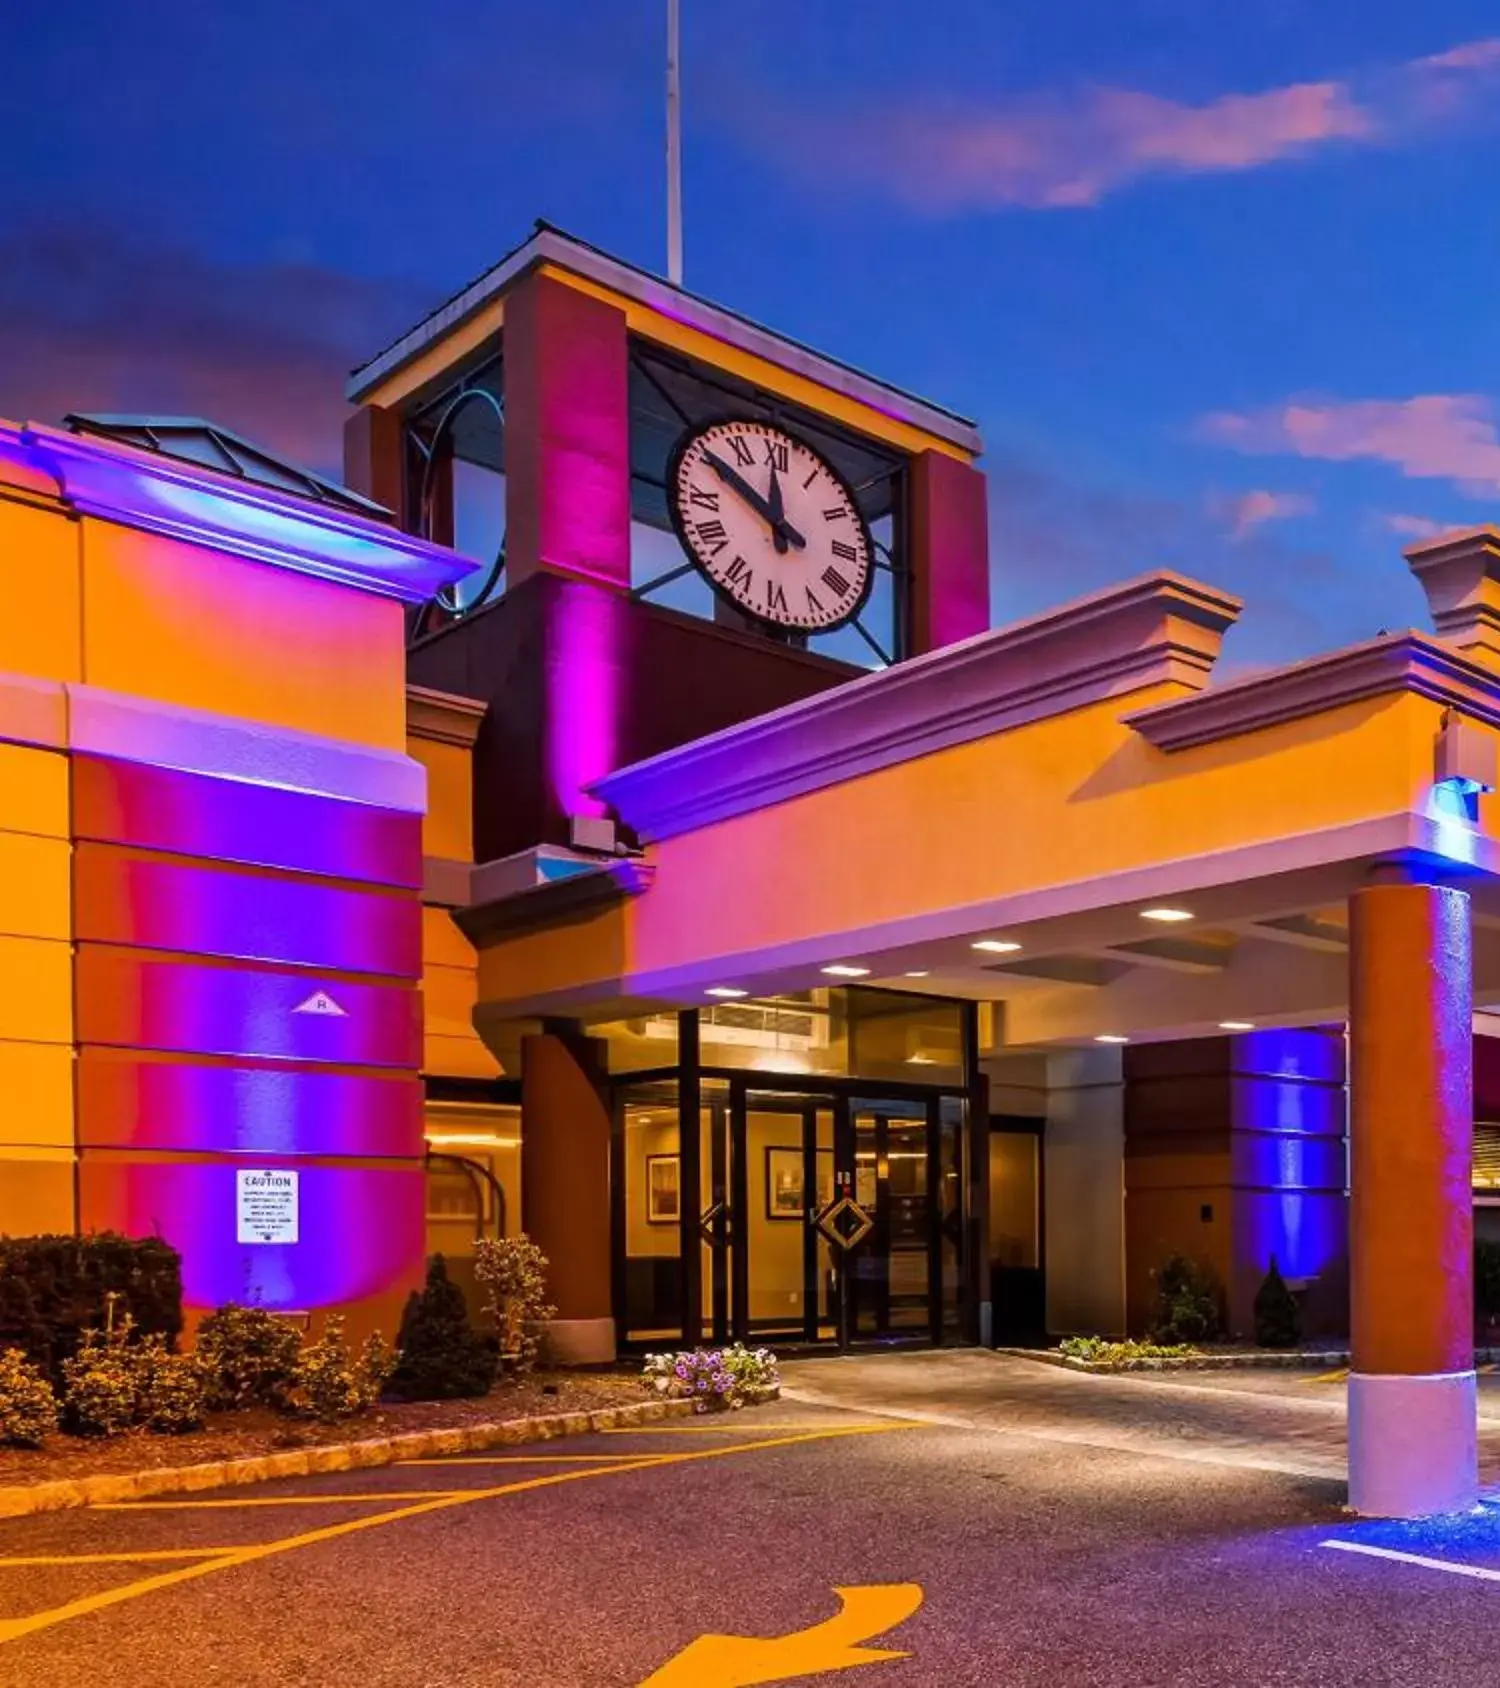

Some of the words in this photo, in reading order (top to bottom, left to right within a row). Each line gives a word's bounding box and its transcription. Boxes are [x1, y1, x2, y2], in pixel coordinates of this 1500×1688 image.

[726, 436, 756, 466] XI
[764, 438, 789, 473] XII
[767, 579, 788, 612] VI
[805, 585, 825, 613] V
[244, 1177, 291, 1187] CAUTION
